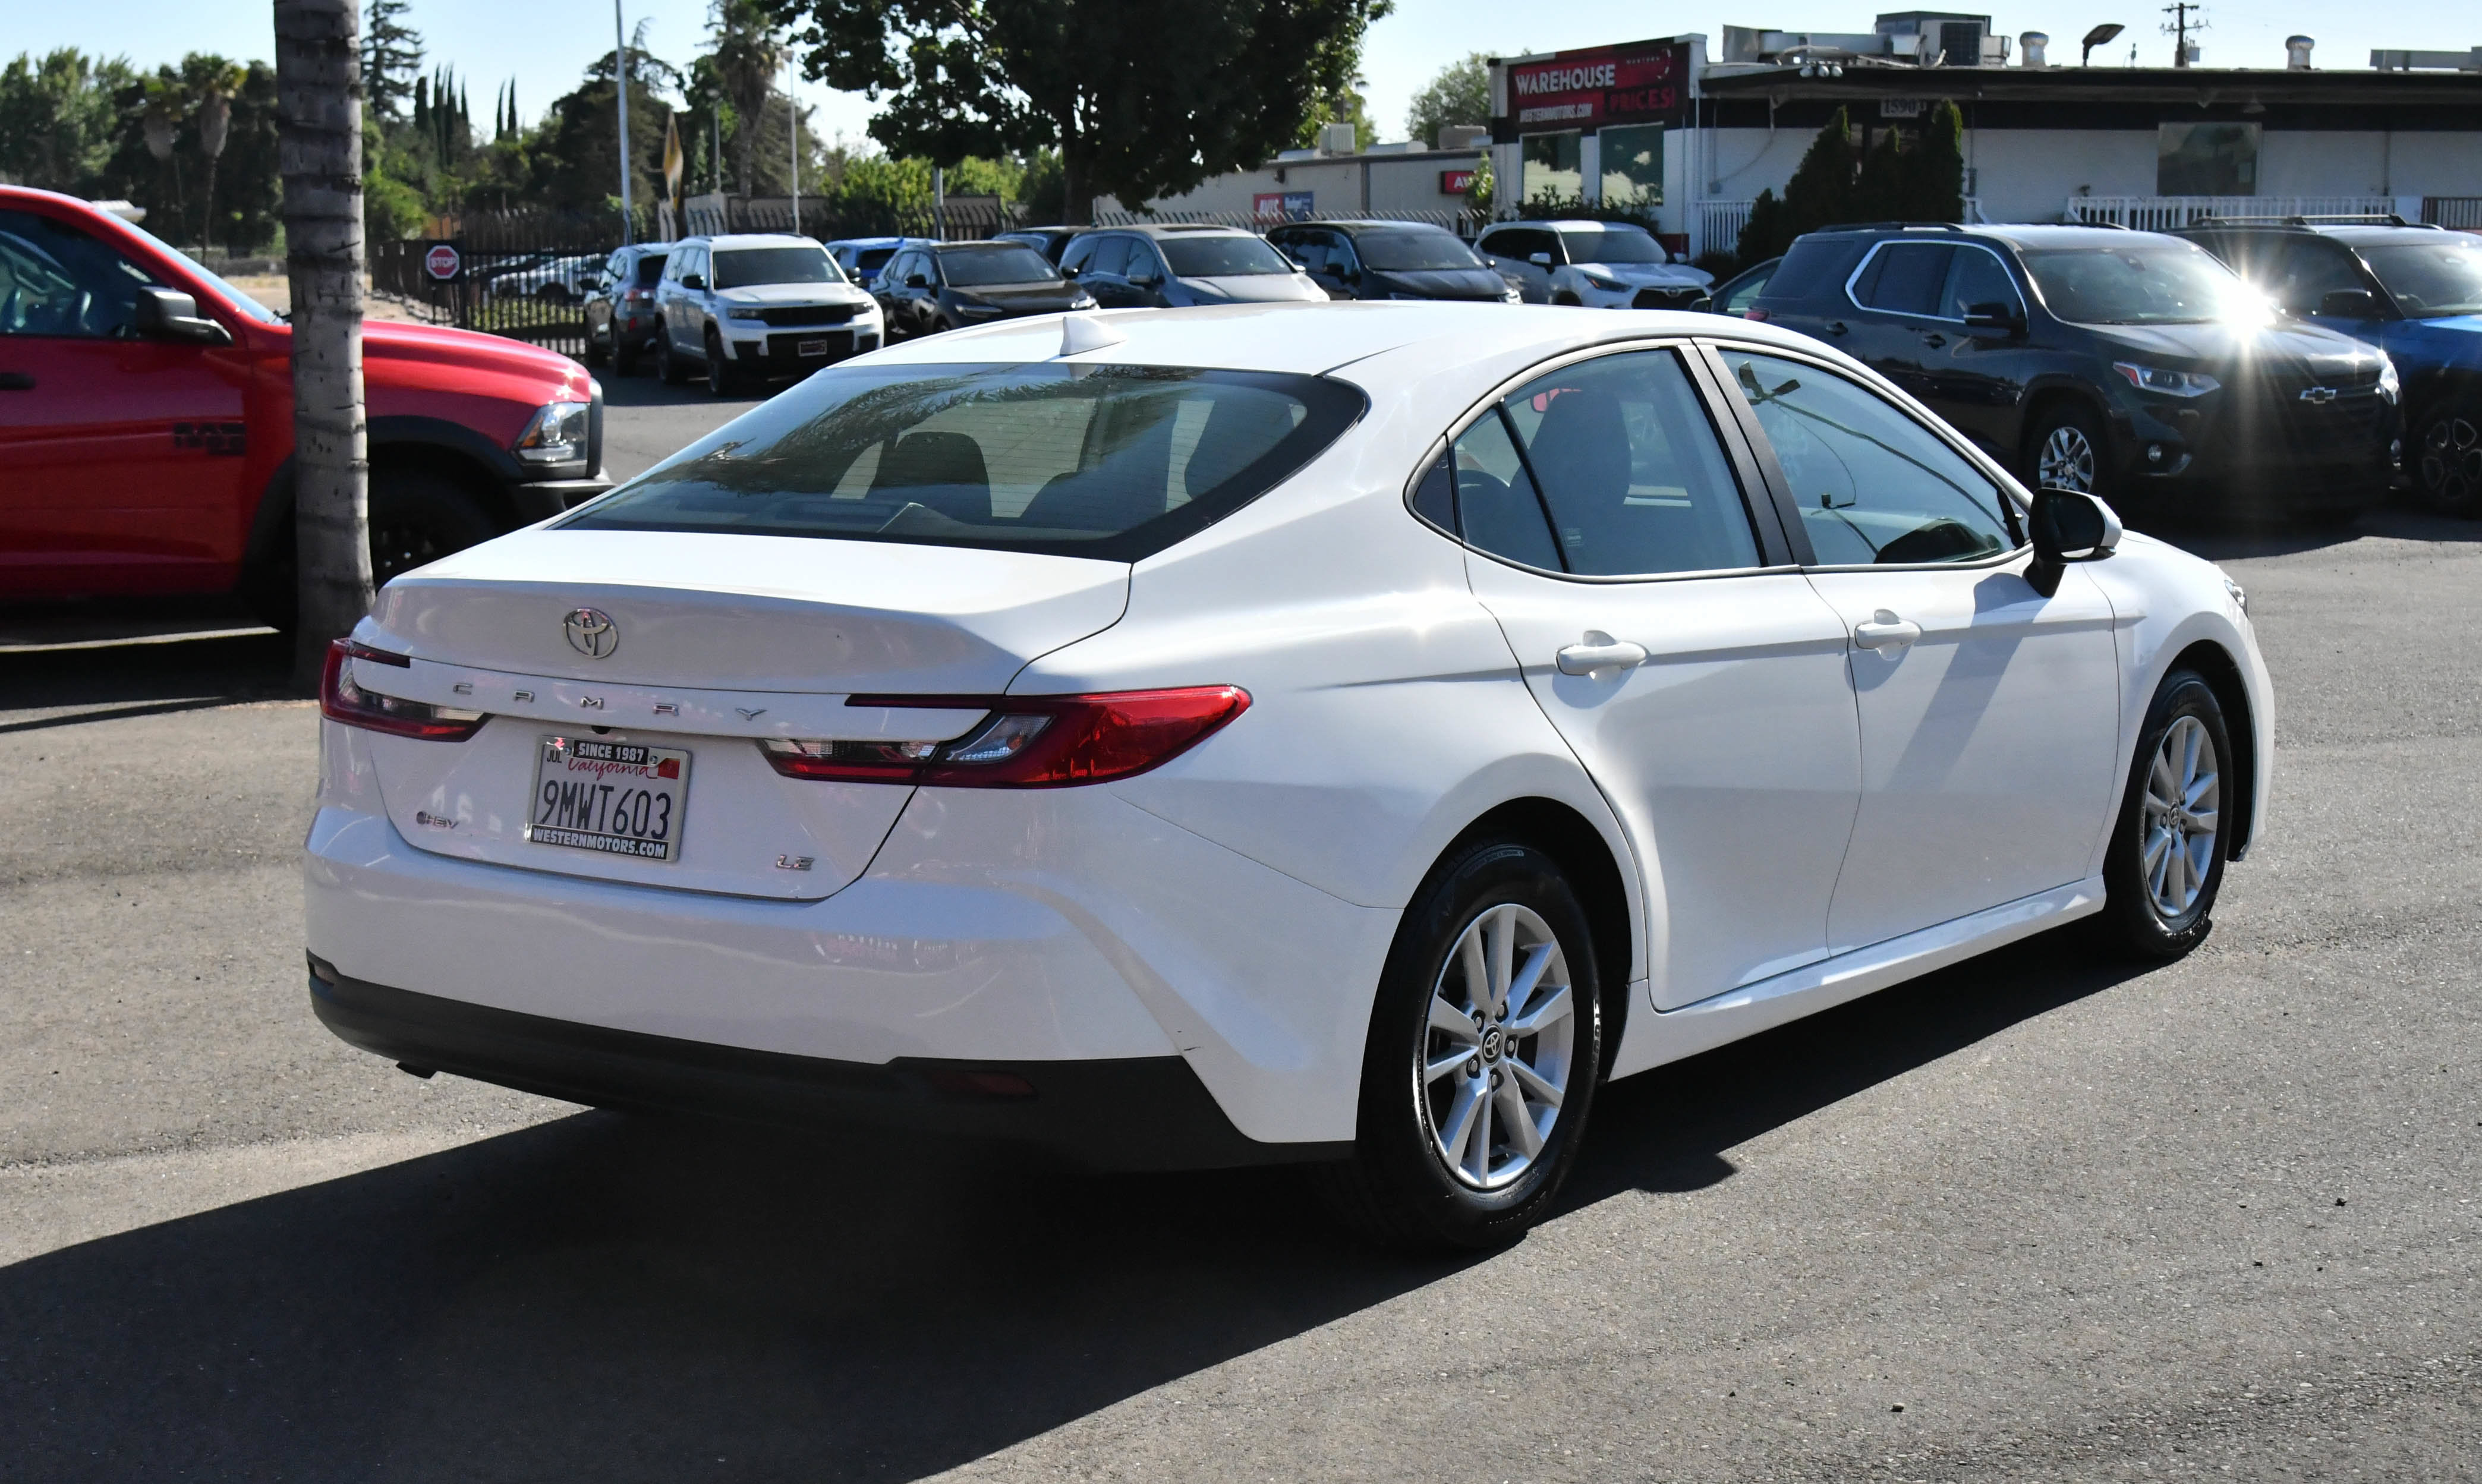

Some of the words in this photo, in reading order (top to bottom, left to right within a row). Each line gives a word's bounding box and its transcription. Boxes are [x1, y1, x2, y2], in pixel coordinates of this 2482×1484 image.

[1516, 64, 1615, 96] WAREHOUSE
[431, 257, 456, 268] STOP
[453, 682, 767, 721] CAMRY
[547, 749, 562, 764] JUL
[578, 742, 612, 759] SINCE
[616, 746, 644, 762] 1987
[539, 780, 672, 840] 9MWT603
[533, 829, 666, 858] WESTERNMOTORS.COM
[776, 854, 814, 871] LE
